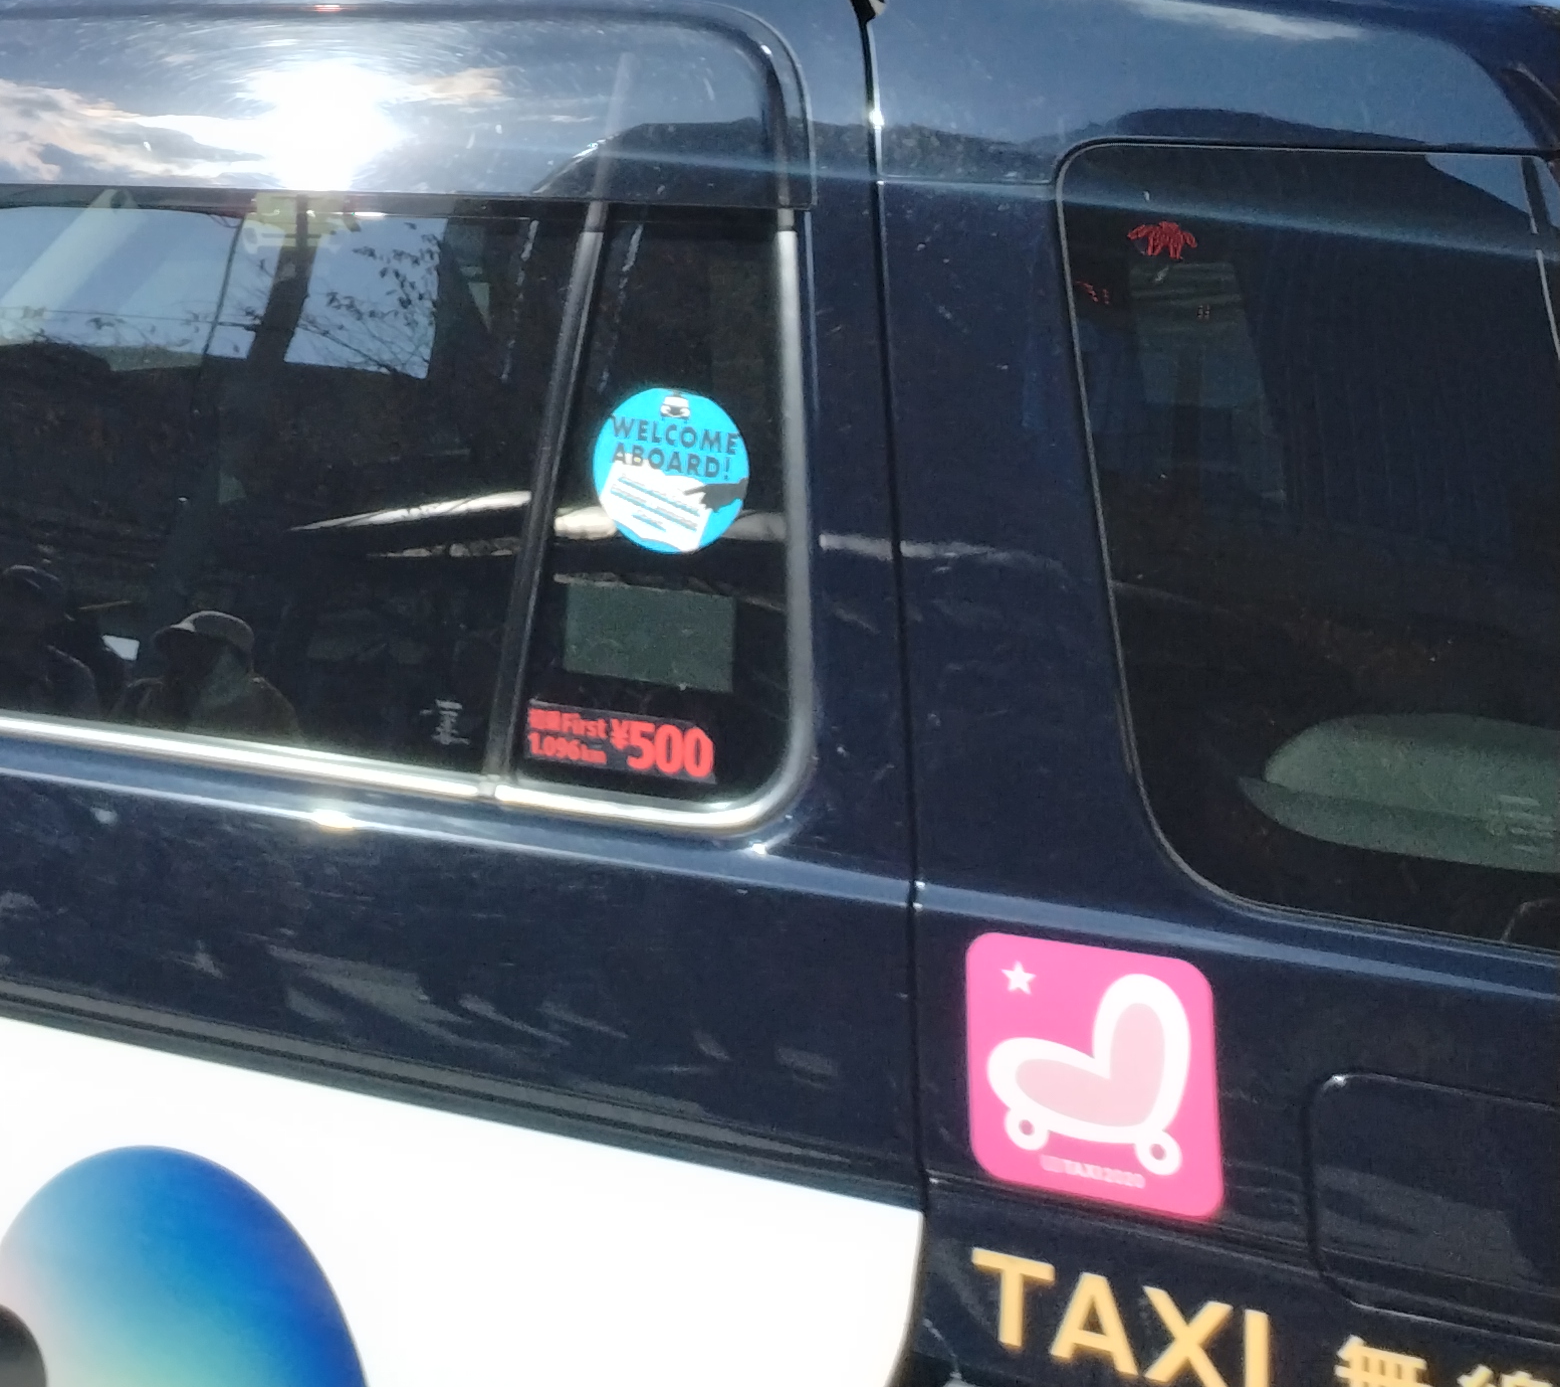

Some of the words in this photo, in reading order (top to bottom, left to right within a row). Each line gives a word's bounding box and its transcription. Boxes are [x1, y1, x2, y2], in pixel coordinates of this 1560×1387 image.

[611, 415, 741, 455] WELCOME
[612, 442, 732, 481] ABOARD!
[609, 717, 715, 778] ¥500
[971, 1246, 1270, 1387] TAXI
